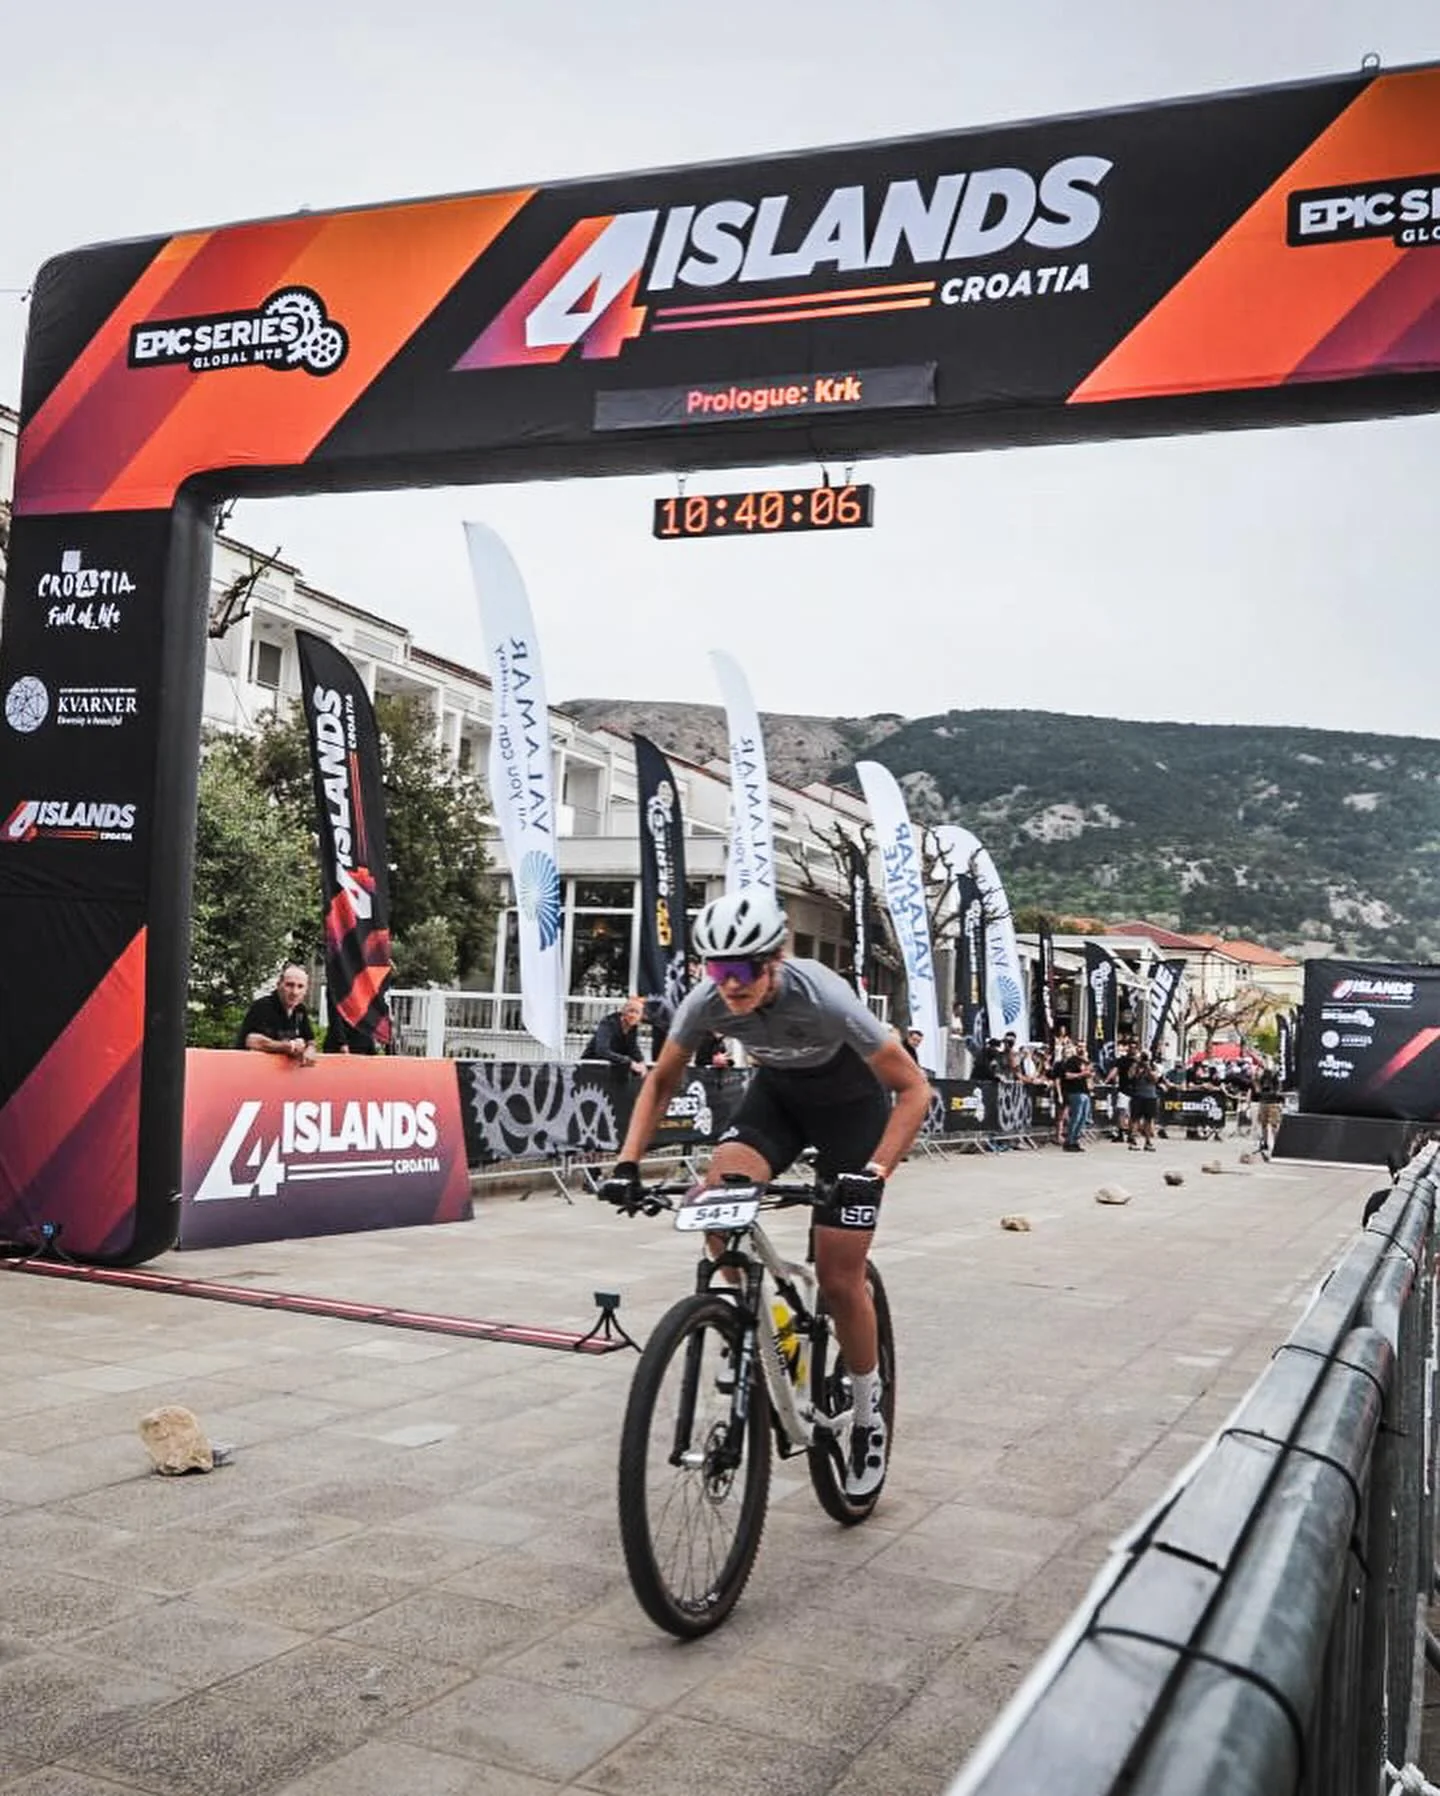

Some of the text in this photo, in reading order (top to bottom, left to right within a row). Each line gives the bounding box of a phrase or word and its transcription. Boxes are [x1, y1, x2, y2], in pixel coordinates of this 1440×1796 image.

[647, 155, 1114, 292] ISLANDS
[1299, 192, 1396, 235] EPIC
[940, 263, 1090, 305] CROATIA
[134, 315, 299, 359] EPIC SERIES
[193, 348, 283, 369] GLOBAL MTB
[686, 376, 862, 414] Prologue: Krk
[660, 485, 862, 535] 10:40:06
[38, 569, 136, 598] CROATIA
[58, 696, 137, 713] KVARNER
[345, 694, 358, 749] CROATIA
[36, 801, 137, 829] ISLANDS
[193, 1100, 437, 1201] 4 ISLANDS
[394, 1158, 440, 1174] CROATIA
